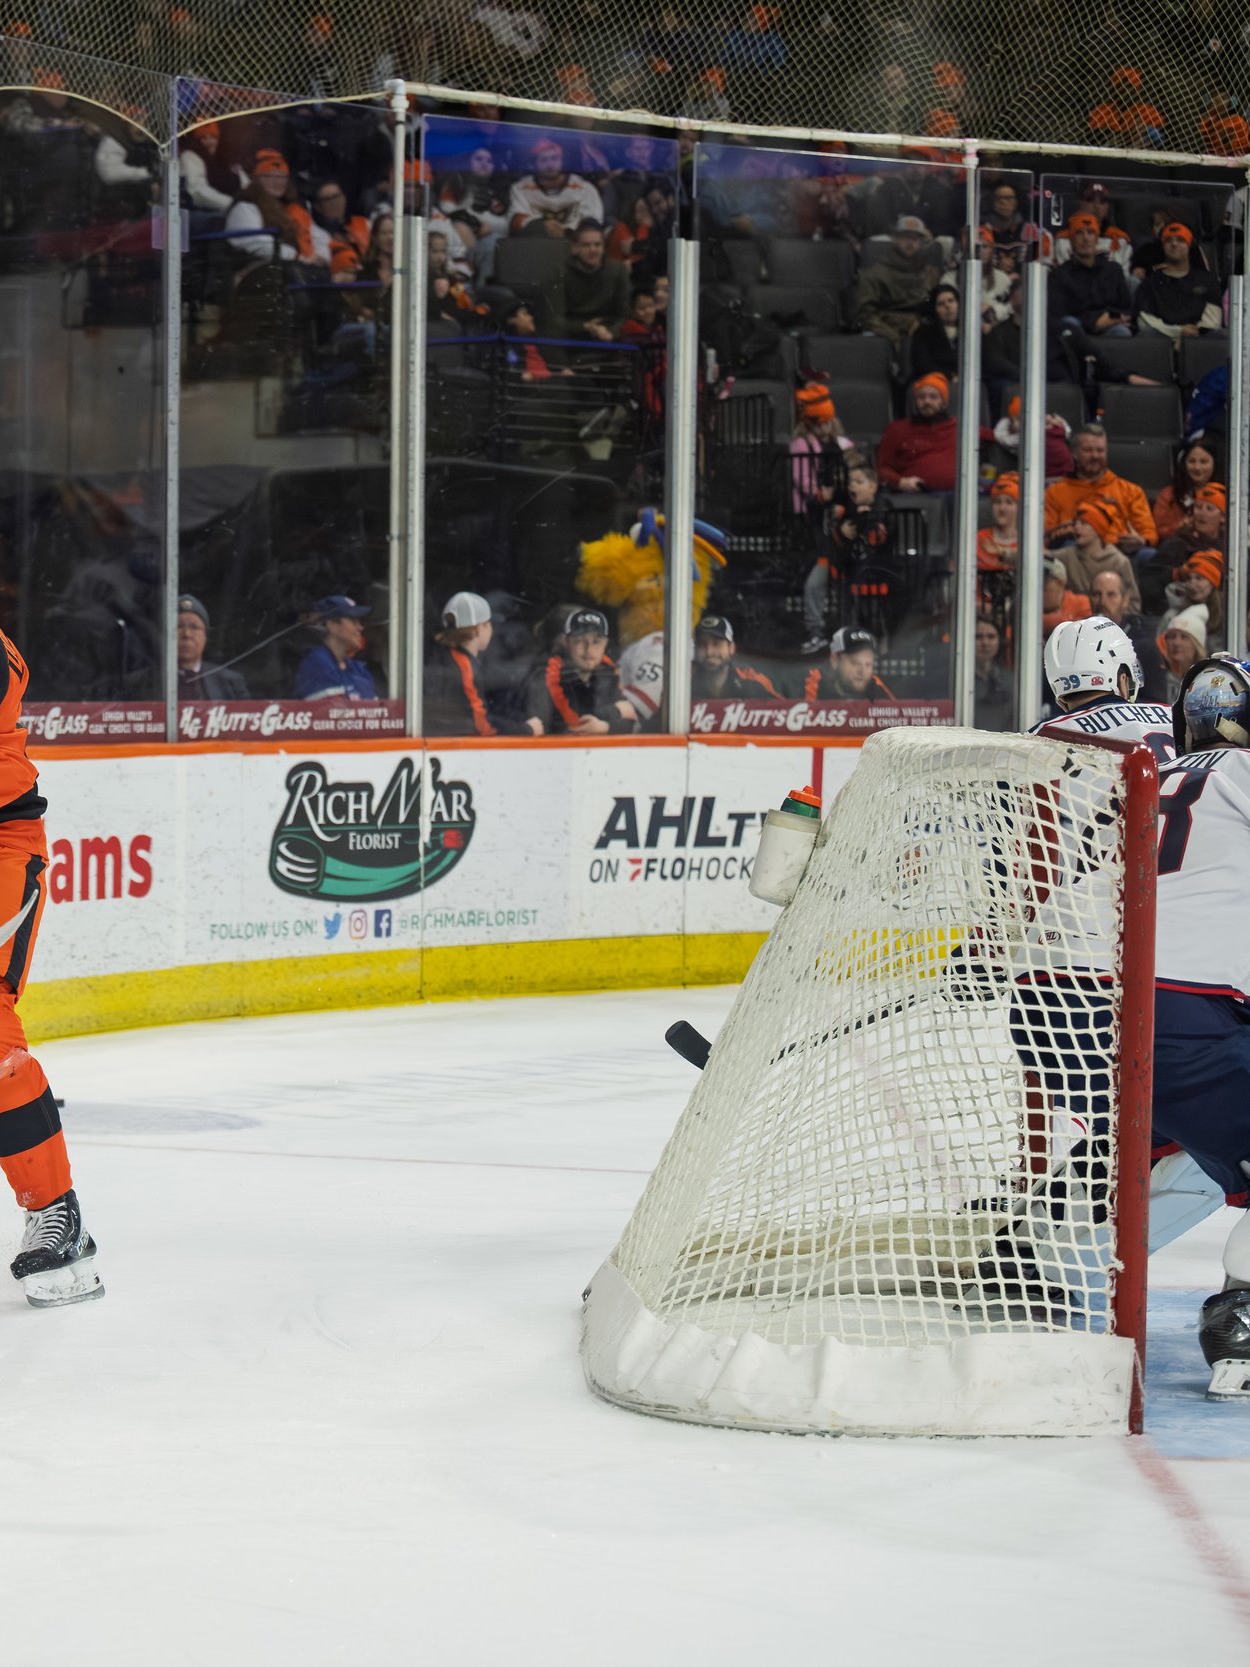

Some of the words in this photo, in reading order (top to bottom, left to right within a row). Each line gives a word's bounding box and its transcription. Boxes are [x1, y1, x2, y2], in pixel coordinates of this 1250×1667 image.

[1060, 674, 1081, 691] 39
[44, 706, 89, 740] GLASS
[204, 705, 261, 738] HUTT'S
[260, 703, 313, 736] GLASS
[313, 720, 336, 731] CLEAR
[365, 719, 380, 730] FOR
[381, 718, 405, 730] GLASS
[719, 702, 787, 732] HUTT'S
[786, 702, 848, 732] GLASS
[848, 718, 875, 728] CLEAR
[877, 717, 908, 727] CHOICE
[911, 717, 928, 727] FOR
[1074, 705, 1173, 734] BUTCHER
[286, 769, 369, 843] RICH
[377, 765, 472, 830] MAR
[349, 831, 402, 850] FLORIST
[50, 833, 153, 904] ams
[589, 858, 619, 883] ON
[210, 922, 267, 940] FOLLOW
[271, 921, 289, 938] US
[399, 909, 538, 931] @RCHMARFLORIST
